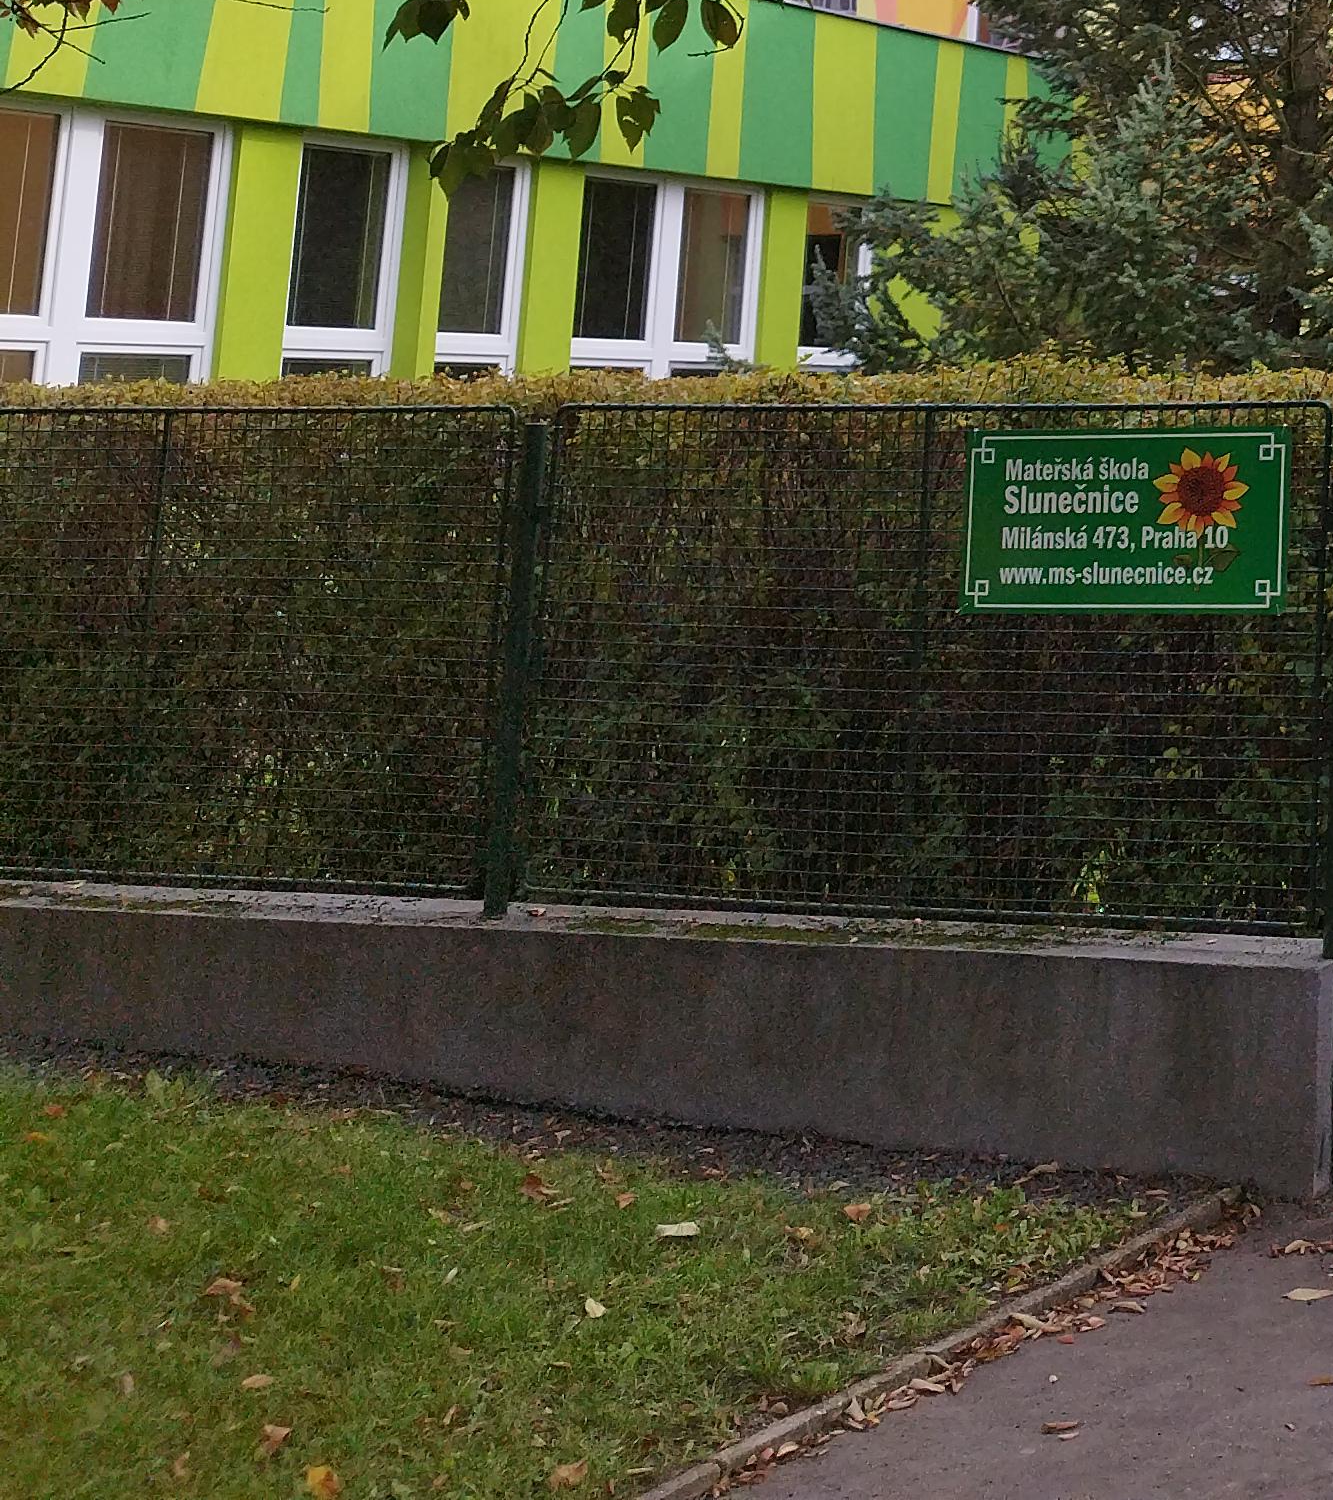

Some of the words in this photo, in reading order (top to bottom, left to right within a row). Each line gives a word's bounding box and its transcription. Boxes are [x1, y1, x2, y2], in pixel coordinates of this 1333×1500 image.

[1005, 457, 1093, 481] Mateřská
[1099, 457, 1149, 481] škola
[1003, 484, 1139, 515] Slunečnice
[1001, 525, 1088, 550] Milánská
[1092, 526, 1135, 553] 473,
[1141, 526, 1198, 549] Praha
[1204, 526, 1229, 549] 10
[999, 562, 1214, 585] www.ms-slunecnice.cz
